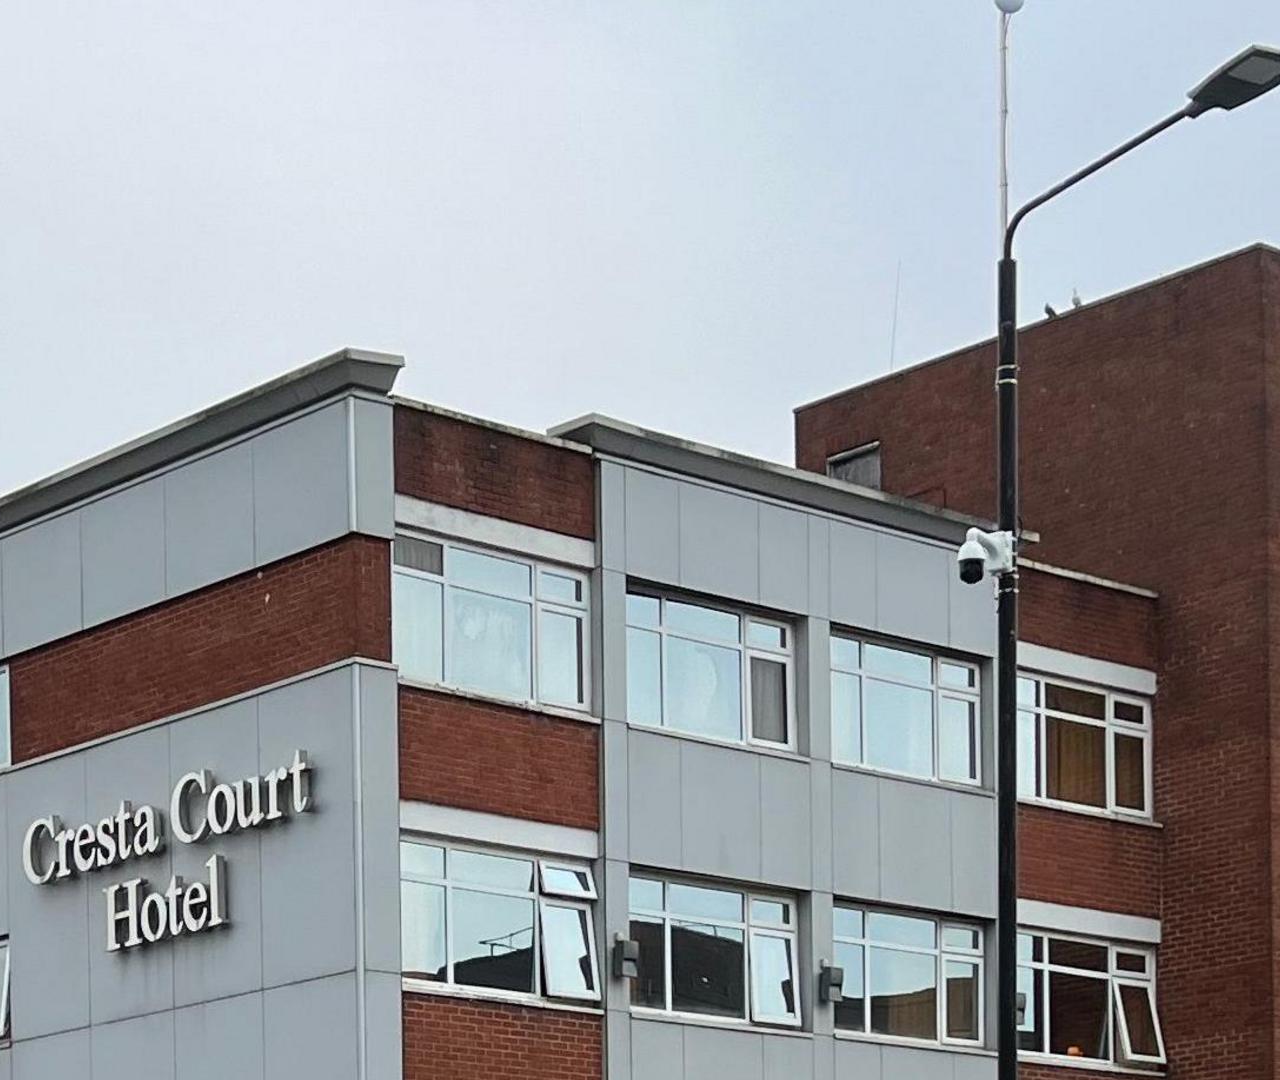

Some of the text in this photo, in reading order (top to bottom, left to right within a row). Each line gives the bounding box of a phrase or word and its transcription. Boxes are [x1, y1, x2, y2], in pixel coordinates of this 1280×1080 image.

[22, 749, 311, 885] Cresta Court
[103, 854, 229, 952] Hotel
